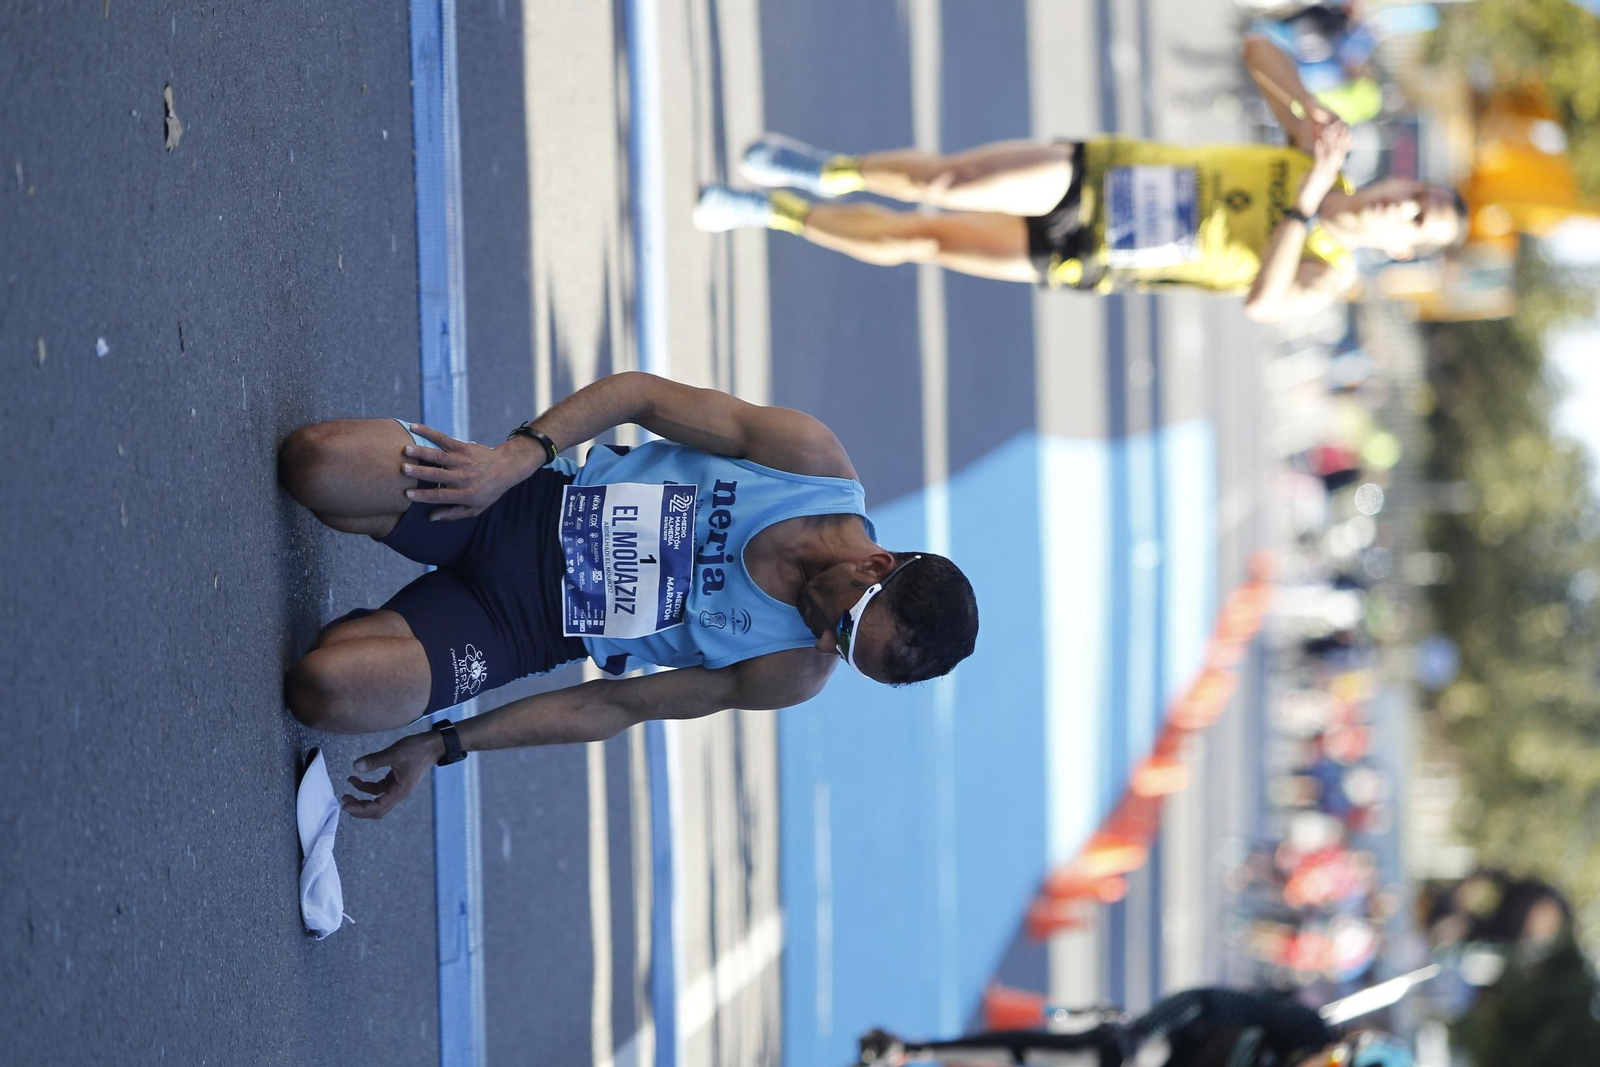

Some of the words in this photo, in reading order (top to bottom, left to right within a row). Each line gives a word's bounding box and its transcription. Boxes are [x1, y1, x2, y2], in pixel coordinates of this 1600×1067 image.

[612, 505, 638, 527] EL
[604, 521, 612, 557] ABDELHADI
[697, 479, 738, 596] nerja
[612, 532, 638, 615] MOUAZIZ
[640, 554, 657, 564] 1
[664, 576, 674, 620] MARATÓN
[673, 592, 683, 618] MEDIO
[458, 659, 468, 694] NERJA
